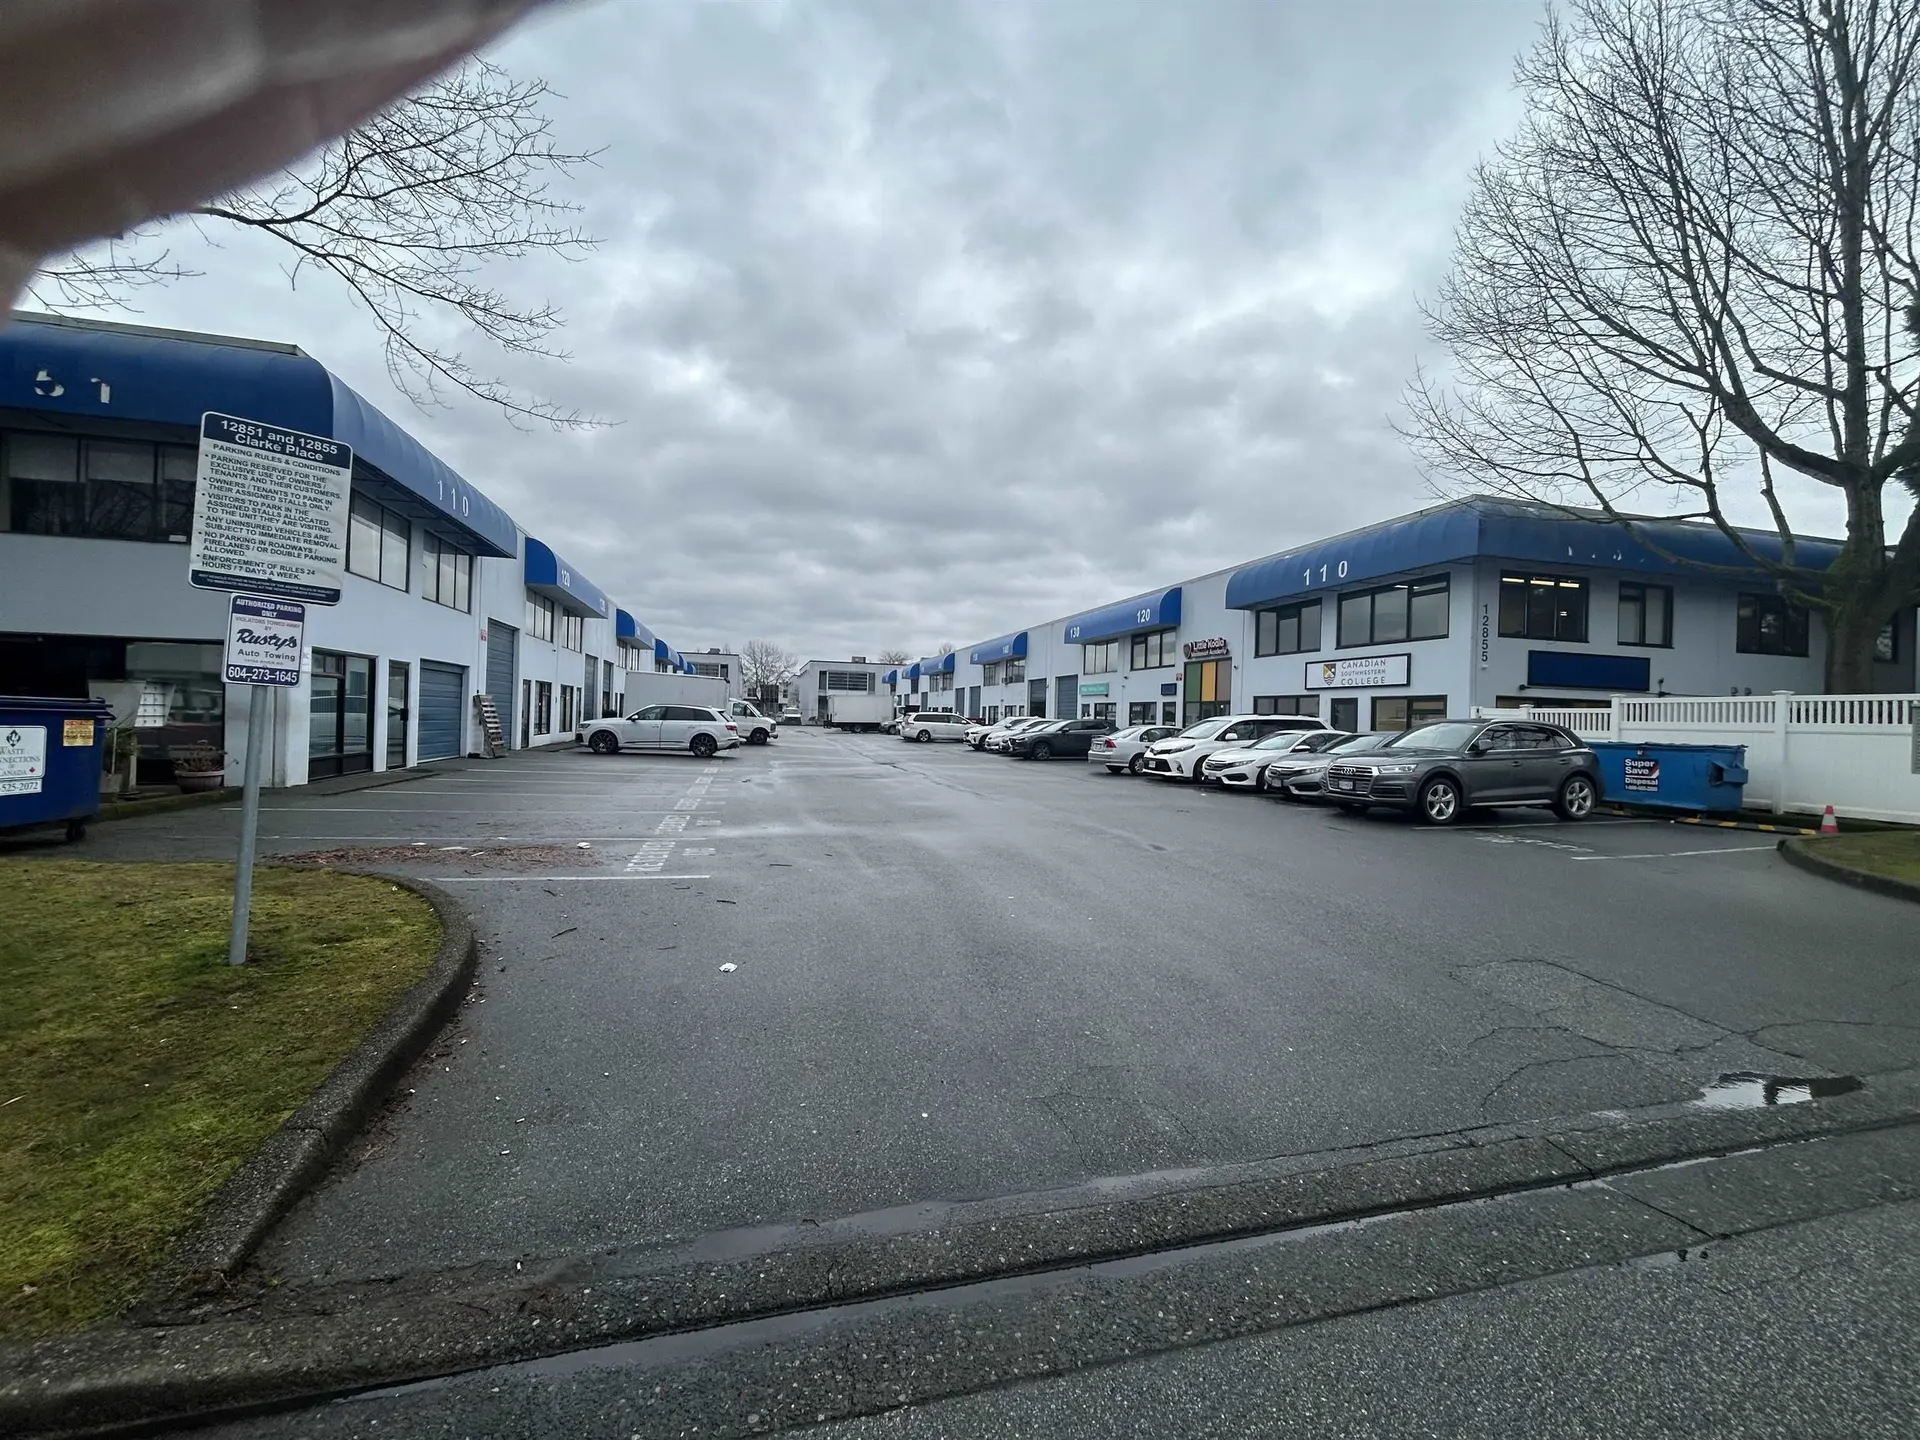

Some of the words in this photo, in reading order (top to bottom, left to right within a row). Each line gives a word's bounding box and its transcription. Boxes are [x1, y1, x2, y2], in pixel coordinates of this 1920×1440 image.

[221, 420, 262, 437] 12851
[268, 432, 294, 444] and
[299, 438, 338, 454] 12855
[235, 433, 281, 451] Clarke
[286, 444, 323, 461] Place
[210, 454, 249, 467] PARKING
[250, 462, 293, 476] RESERVED
[294, 471, 310, 480] FOR
[312, 475, 327, 484] THE
[213, 443, 253, 457] PARKING
[254, 452, 283, 463] RULES
[292, 461, 340, 476] CONDITIONS
[210, 461, 256, 475] EXCLUSIVE
[258, 471, 275, 480] USE
[288, 477, 322, 489] OWNERS
[210, 467, 248, 481] TENANTS
[250, 476, 267, 484] AND
[270, 480, 292, 490] THEIR
[208, 483, 234, 493] THEIR
[235, 489, 276, 501] ASSIGNED
[278, 497, 307, 507] STALLS
[209, 477, 246, 489] OWNERS
[252, 484, 288, 497] TENANTS
[291, 492, 301, 500] TO
[302, 495, 324, 504] PARK
[437, 480, 469, 517] 110
[207, 492, 246, 505] VISITORS
[247, 499, 259, 507] TO
[261, 502, 283, 511] PARK
[294, 508, 309, 516] THE
[207, 499, 250, 512] ASSIGNED
[251, 507, 281, 518] STALLS
[283, 513, 329, 526] ALLOCATED
[205, 515, 224, 523] ANY
[226, 519, 273, 531] UNINSURED
[275, 527, 312, 538] VEHICLES
[220, 508, 237, 517] THE
[239, 512, 258, 520] UNIT
[260, 516, 280, 524] THEY
[204, 531, 217, 539] NO
[219, 533, 257, 544] PARKING
[268, 541, 313, 554] ROADWAYS
[205, 522, 244, 533] SUBJECT
[246, 528, 256, 536] TO
[258, 531, 301, 543] IMMEDIATE
[203, 538, 250, 550] FIRELANES
[270, 548, 302, 559] DOUBLE
[304, 553, 338, 564] PARKING
[202, 553, 265, 568] ENFORCEMENT
[279, 564, 305, 574] RULES
[202, 561, 232, 570] HOURS
[245, 567, 267, 575] DAYS
[1303, 560, 1348, 586] 110
[236, 598, 275, 610] AUTHORIZED
[276, 604, 302, 613] PARKING
[261, 610, 277, 618] ONLY
[1137, 608, 1151, 623] 120
[236, 628, 297, 651] Rusty's
[1070, 626, 1080, 638] 130
[237, 649, 260, 657] Auto
[264, 650, 296, 662] Towing
[1341, 659, 1386, 669] CANADIAN
[228, 666, 298, 683] 604-273-1645
[1341, 669, 1386, 677] SOUTHWESTERN
[1341, 676, 1386, 685] COLLEGE
[1625, 759, 1655, 768] Super
[1625, 766, 1649, 775] Save
